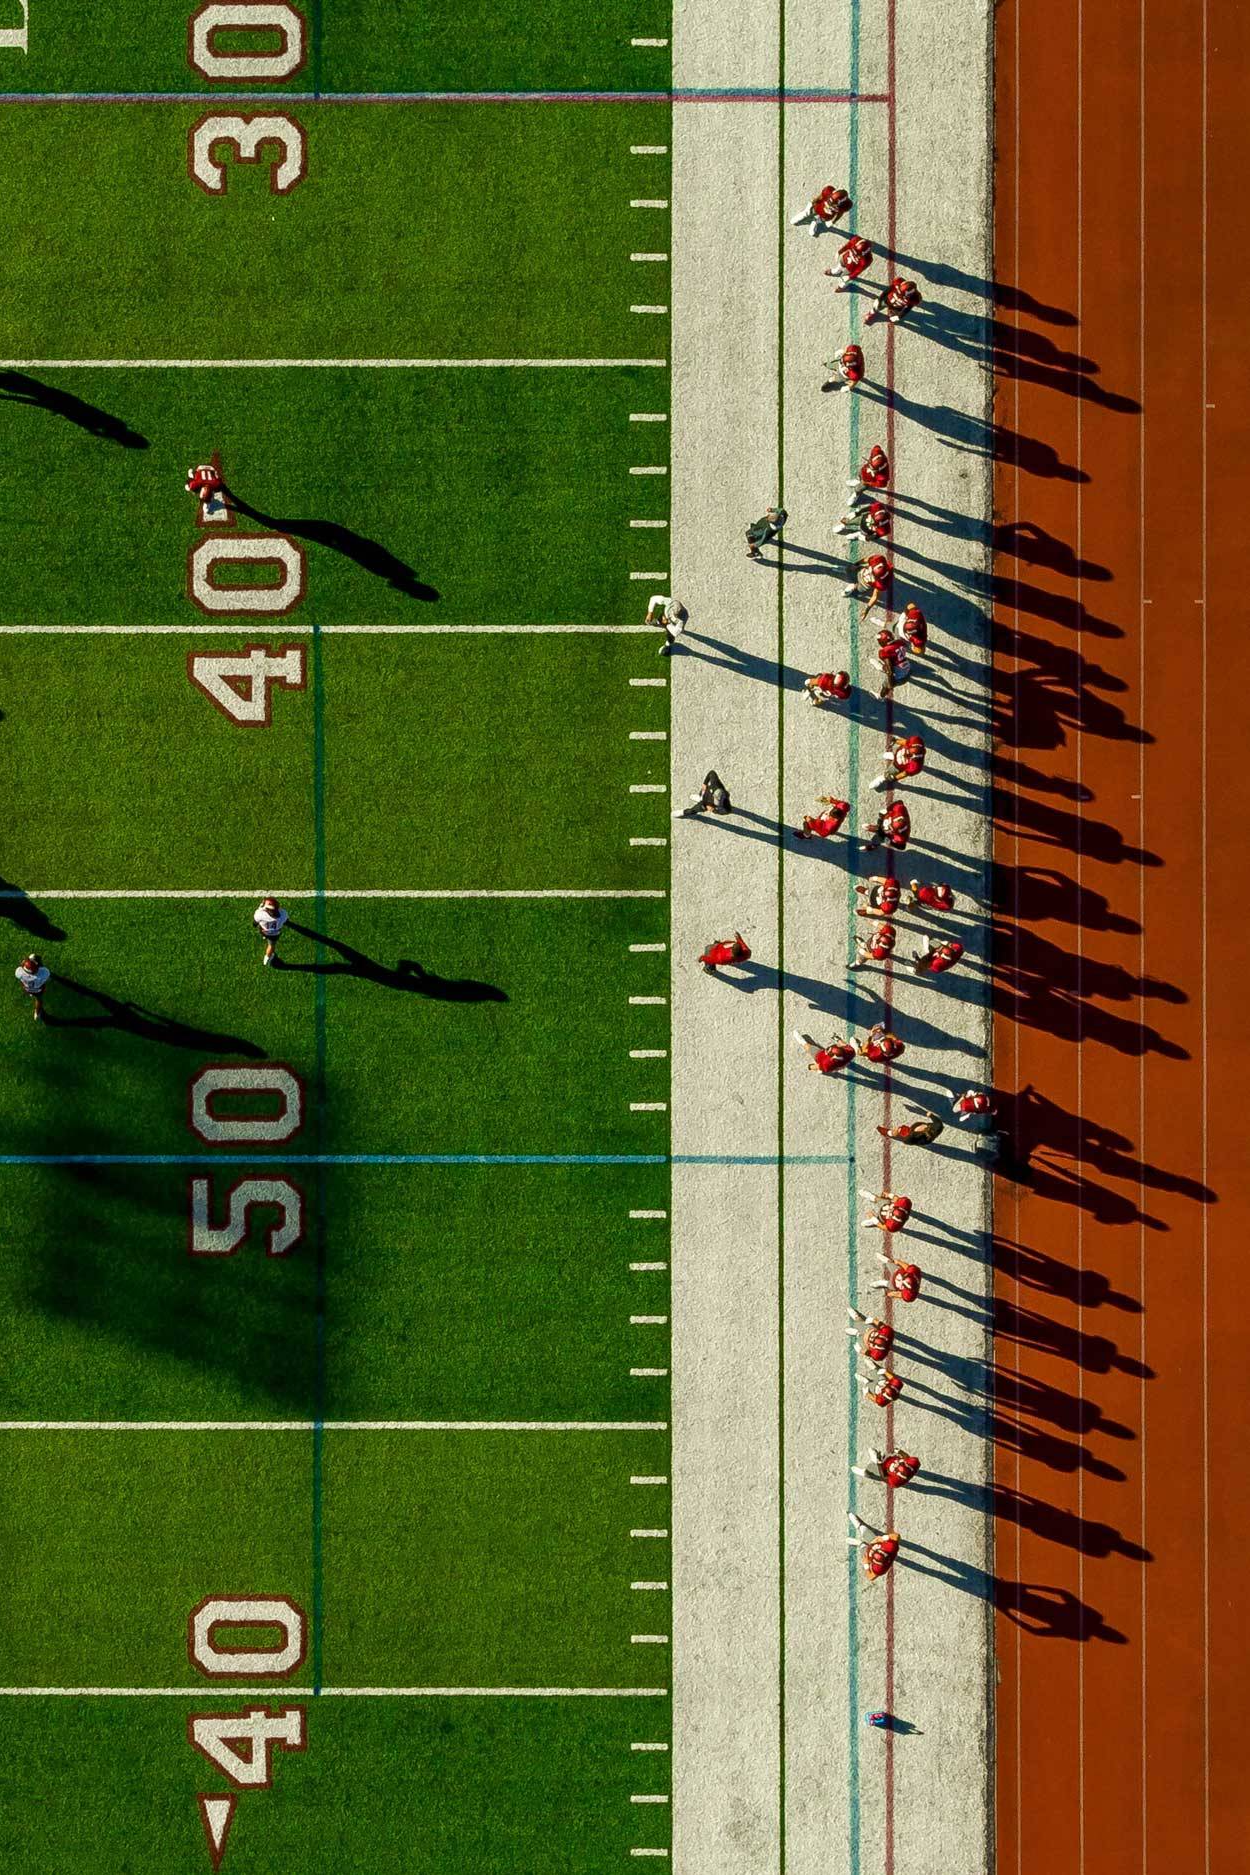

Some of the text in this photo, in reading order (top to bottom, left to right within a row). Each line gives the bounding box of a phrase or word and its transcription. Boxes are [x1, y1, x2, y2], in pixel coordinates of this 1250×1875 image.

[188, 0, 307, 195] 30
[187, 532, 307, 728] 40
[188, 1062, 305, 1257] 50
[187, 1594, 307, 1789] 40
